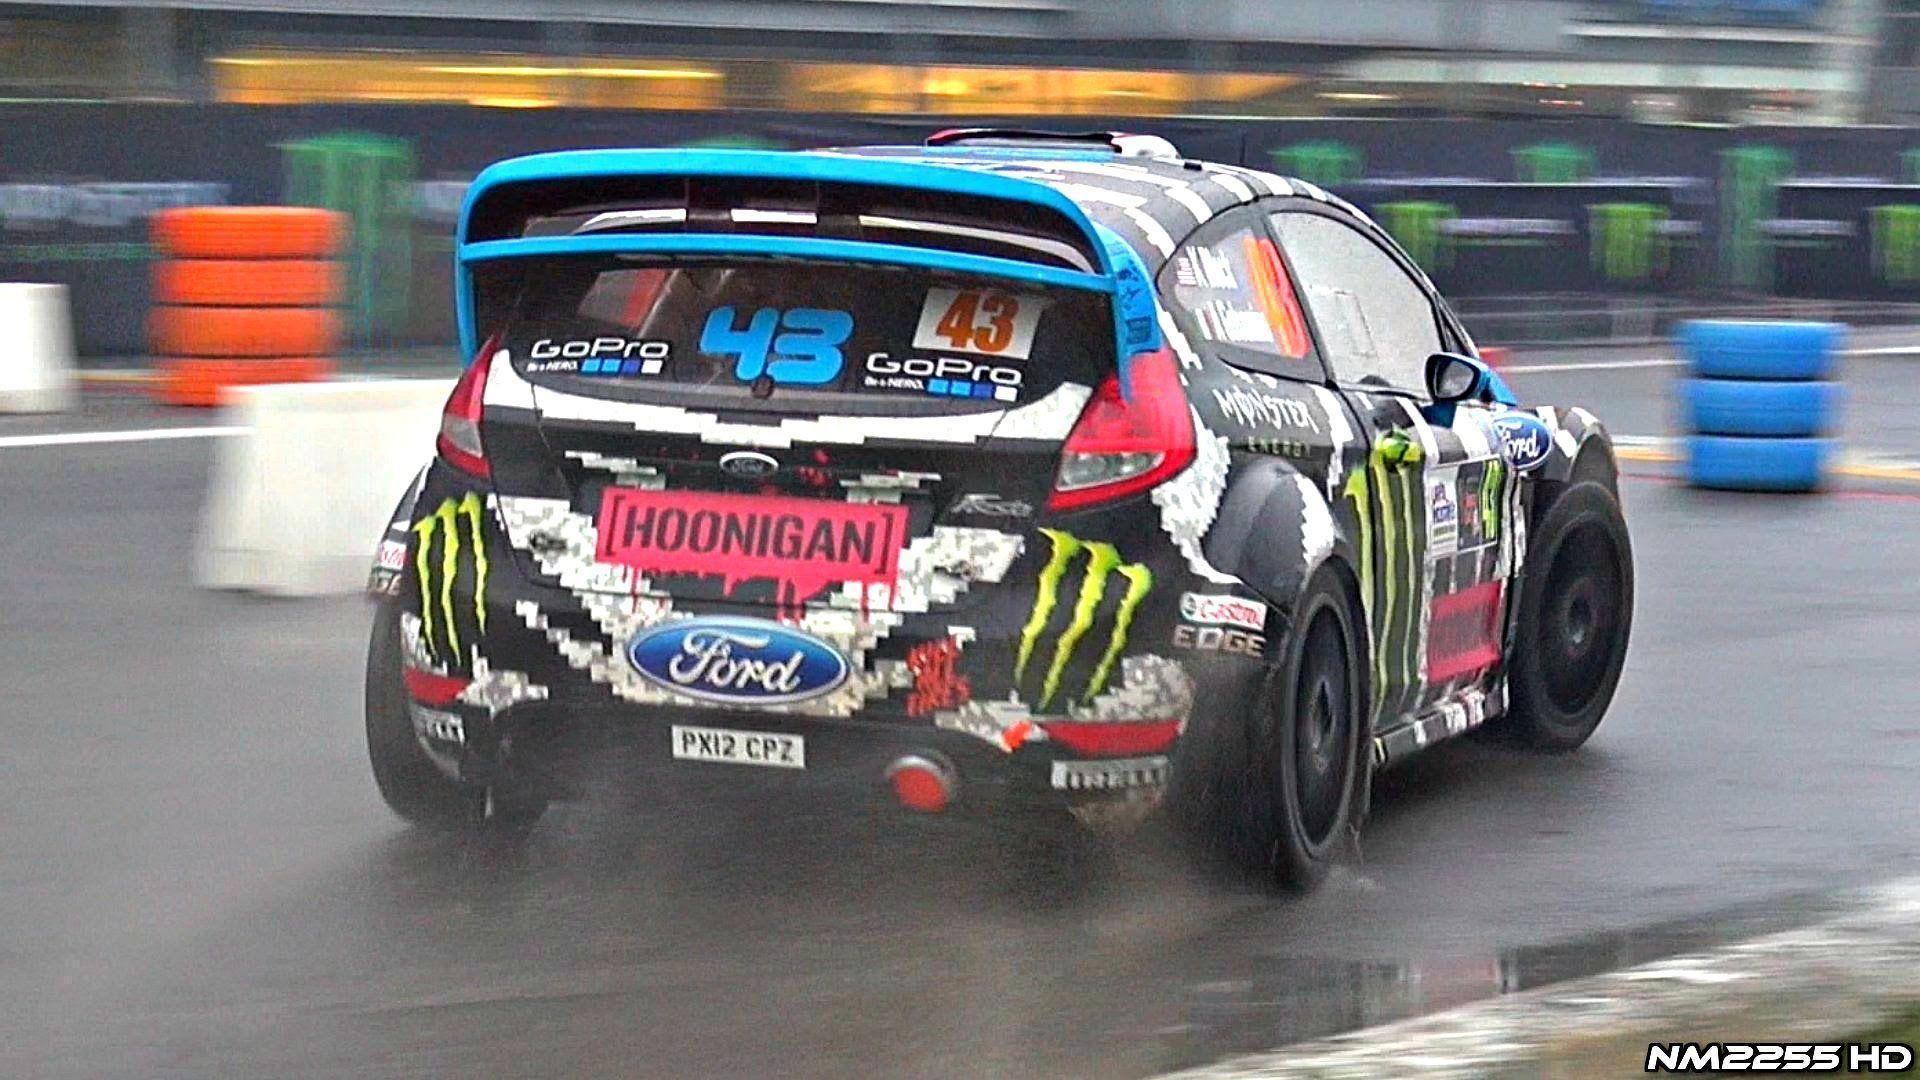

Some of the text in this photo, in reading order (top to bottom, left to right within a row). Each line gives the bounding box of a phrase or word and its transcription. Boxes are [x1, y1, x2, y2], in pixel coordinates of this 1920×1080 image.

[935, 291, 1019, 353] 43
[531, 338, 669, 359] GoPro
[700, 306, 854, 384] 43
[866, 352, 1022, 385] GoPro
[1174, 625, 1267, 657] EDGE
[668, 629, 805, 693] Ford
[744, 736, 796, 763] CPZ
